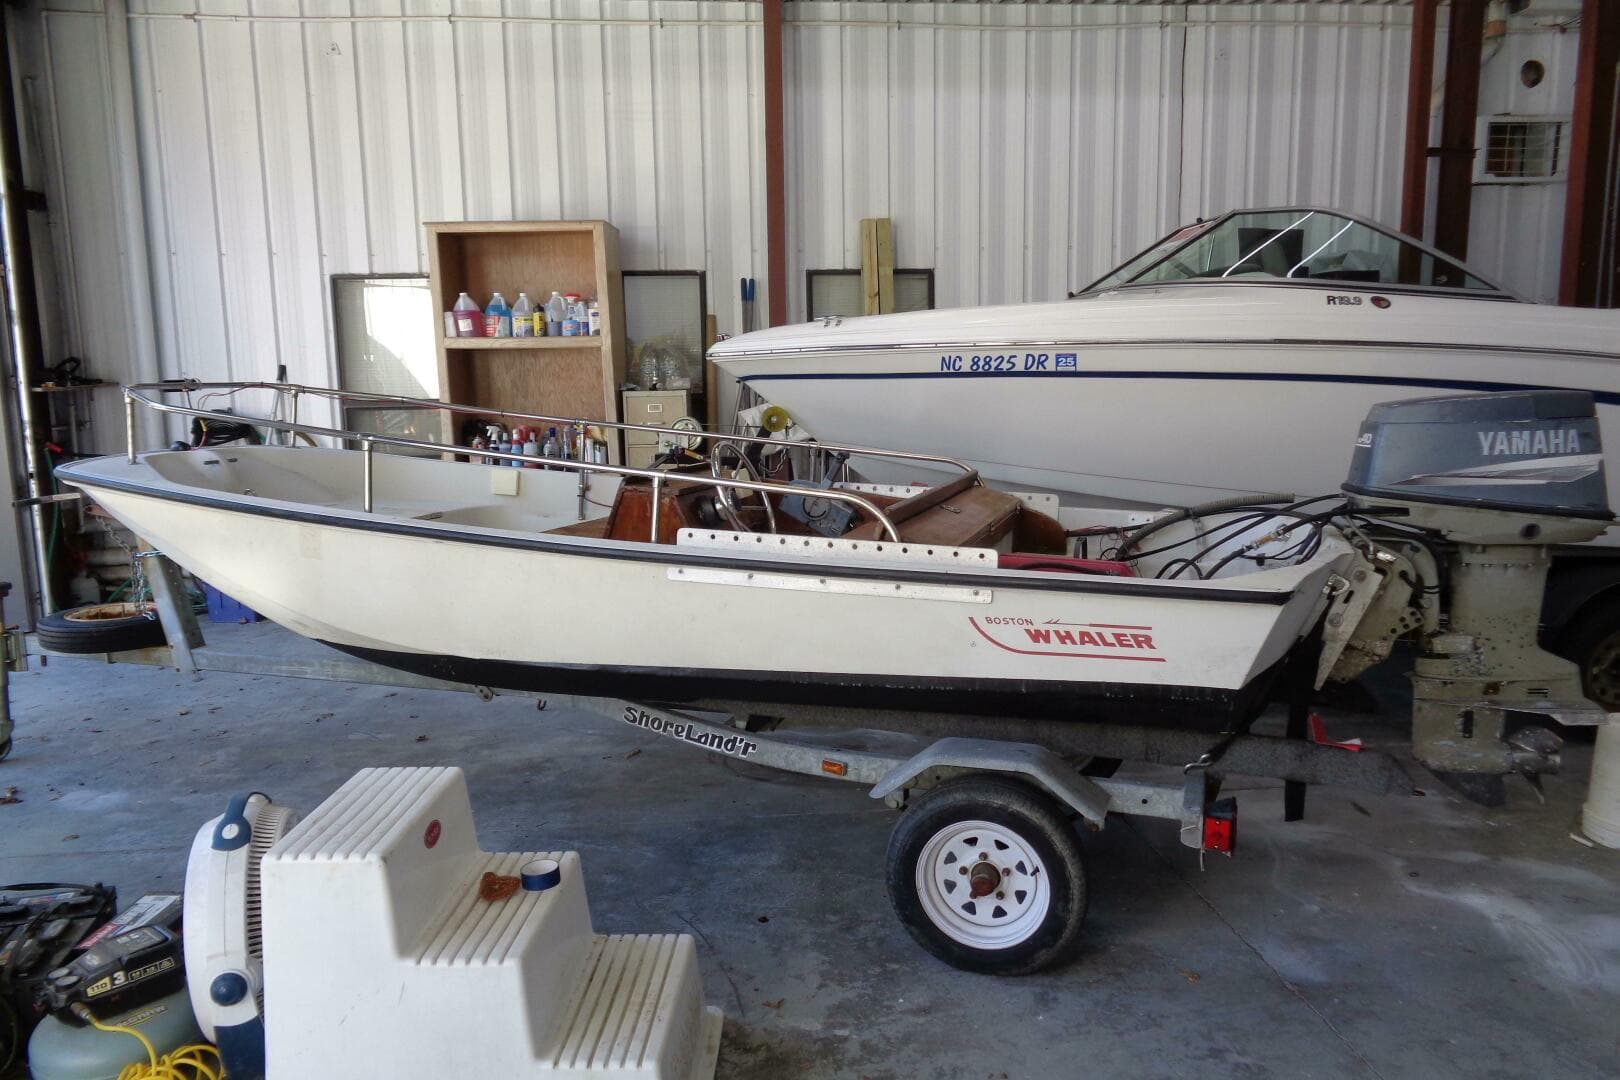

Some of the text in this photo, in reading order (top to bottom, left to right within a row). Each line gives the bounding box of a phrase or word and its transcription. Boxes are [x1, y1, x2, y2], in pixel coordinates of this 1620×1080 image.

[940, 353, 1049, 372] NC 8825 DR
[1057, 356, 1075, 367] 25
[1478, 429, 1581, 455] YAMAHA
[984, 616, 1035, 626] BOSTON
[1024, 628, 1157, 650] WHALER
[623, 705, 757, 757] ShoreLand'r
[113, 970, 126, 986] 3
